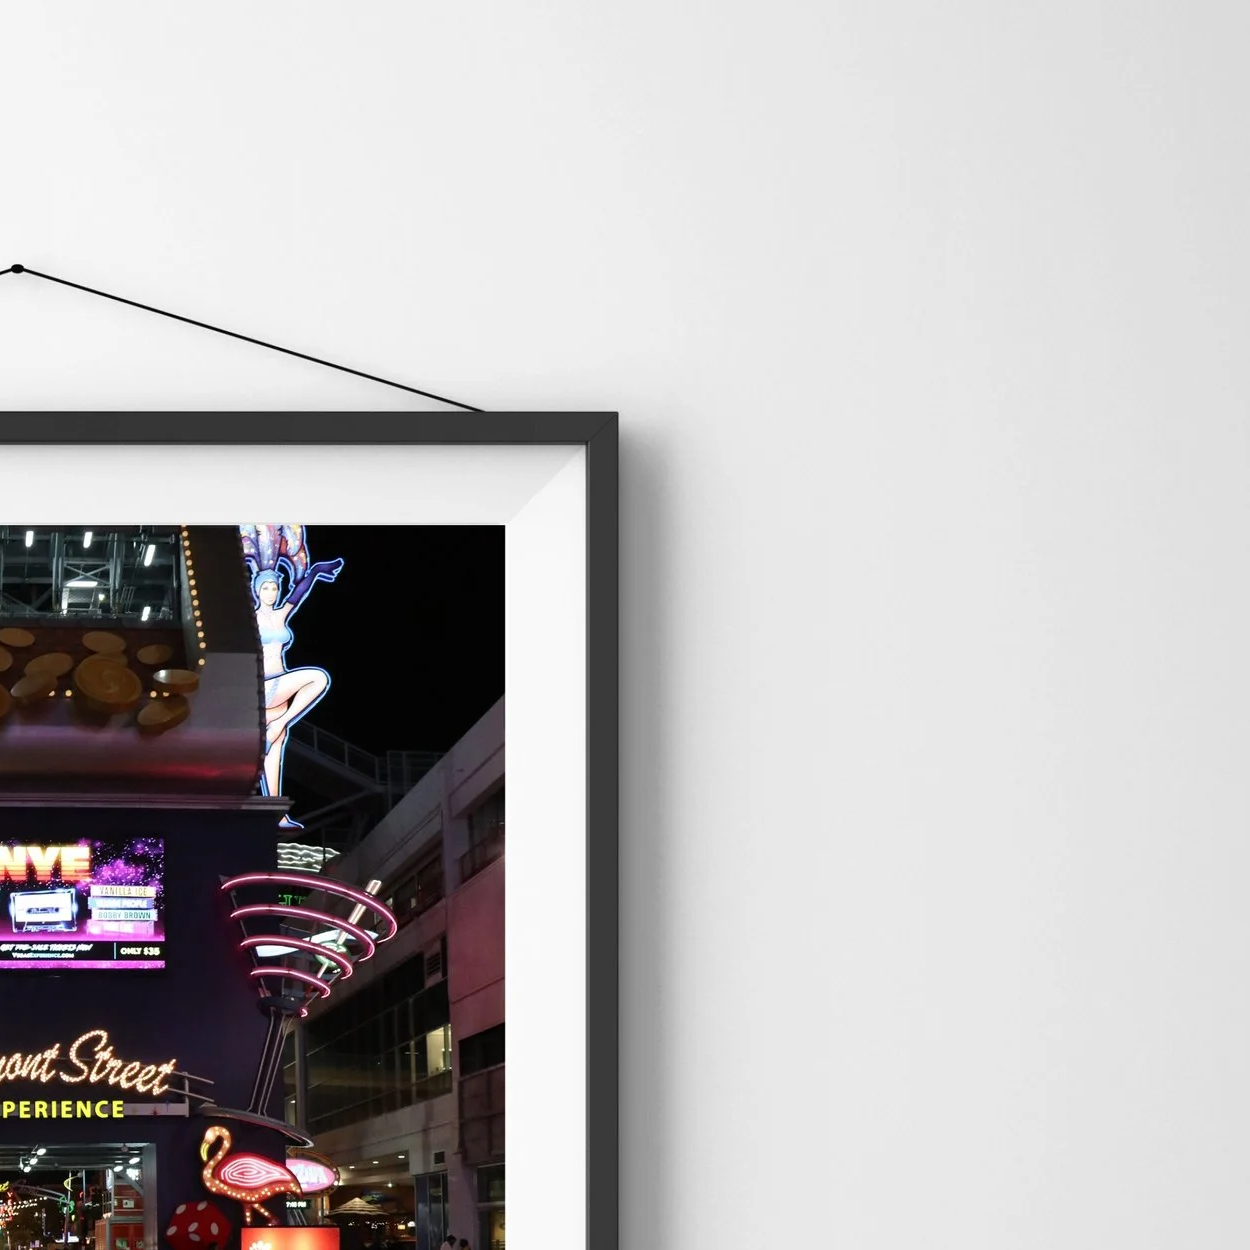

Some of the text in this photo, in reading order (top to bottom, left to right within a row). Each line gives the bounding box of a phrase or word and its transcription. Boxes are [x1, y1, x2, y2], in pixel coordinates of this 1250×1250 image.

[100, 886, 148, 896] VANILLA ICE
[98, 911, 151, 919] BOBBY BROWN
[120, 947, 142, 955] ONLY
[59, 1029, 177, 1096] Street
